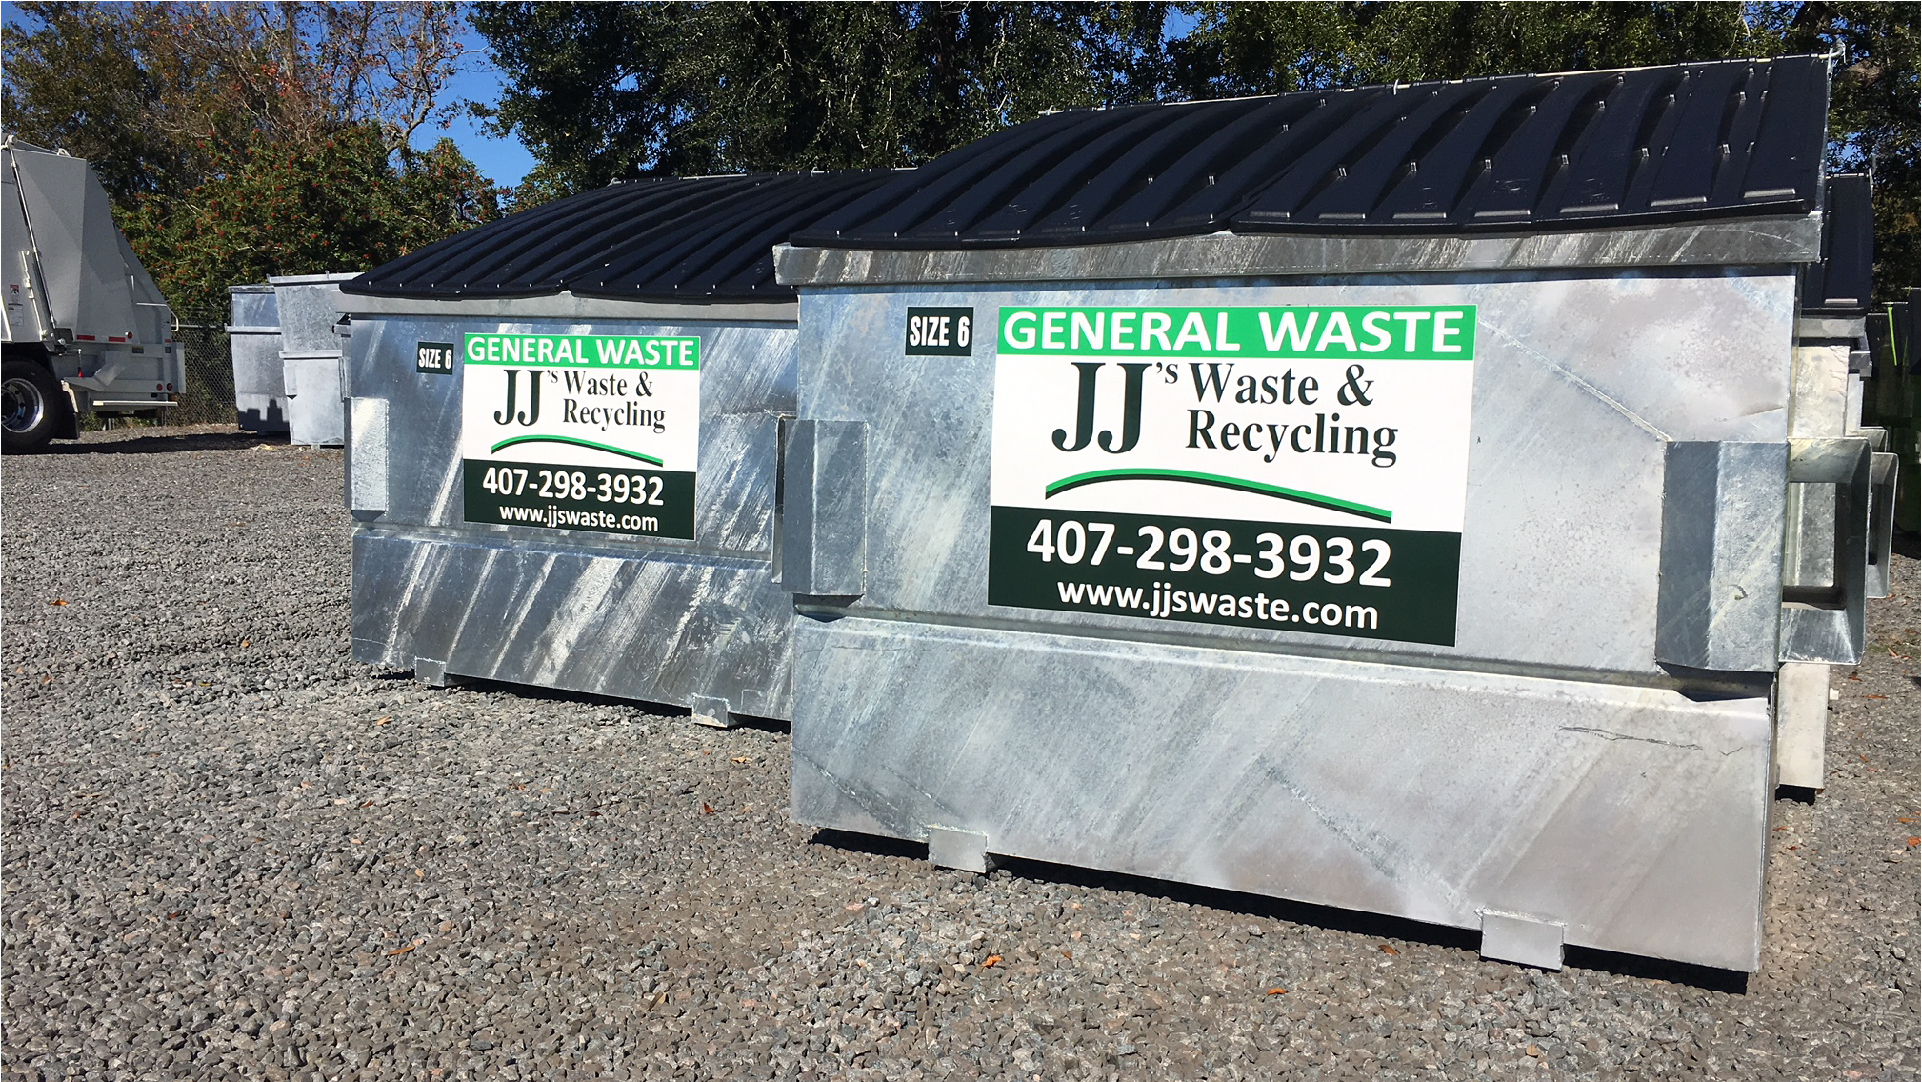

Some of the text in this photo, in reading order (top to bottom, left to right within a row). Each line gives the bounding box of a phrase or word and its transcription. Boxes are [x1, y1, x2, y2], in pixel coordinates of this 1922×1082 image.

[910, 314, 971, 349] SIZE 6
[1003, 310, 1464, 354] GENERAL WASTE
[418, 347, 452, 370] SIZE 6
[467, 336, 694, 366] GENERAL WASTE
[563, 370, 627, 397] Waste
[635, 370, 653, 397] &
[1188, 363, 1319, 406] Waste
[1336, 363, 1375, 407] &
[562, 398, 666, 434] Recycling
[1185, 409, 1399, 468] Recycling
[482, 467, 664, 506] 407-298-3932
[499, 504, 658, 532] www.jjswaste.com
[1026, 518, 1393, 588] 407-298-3932
[1057, 579, 1379, 630] www.jjswaste.com
